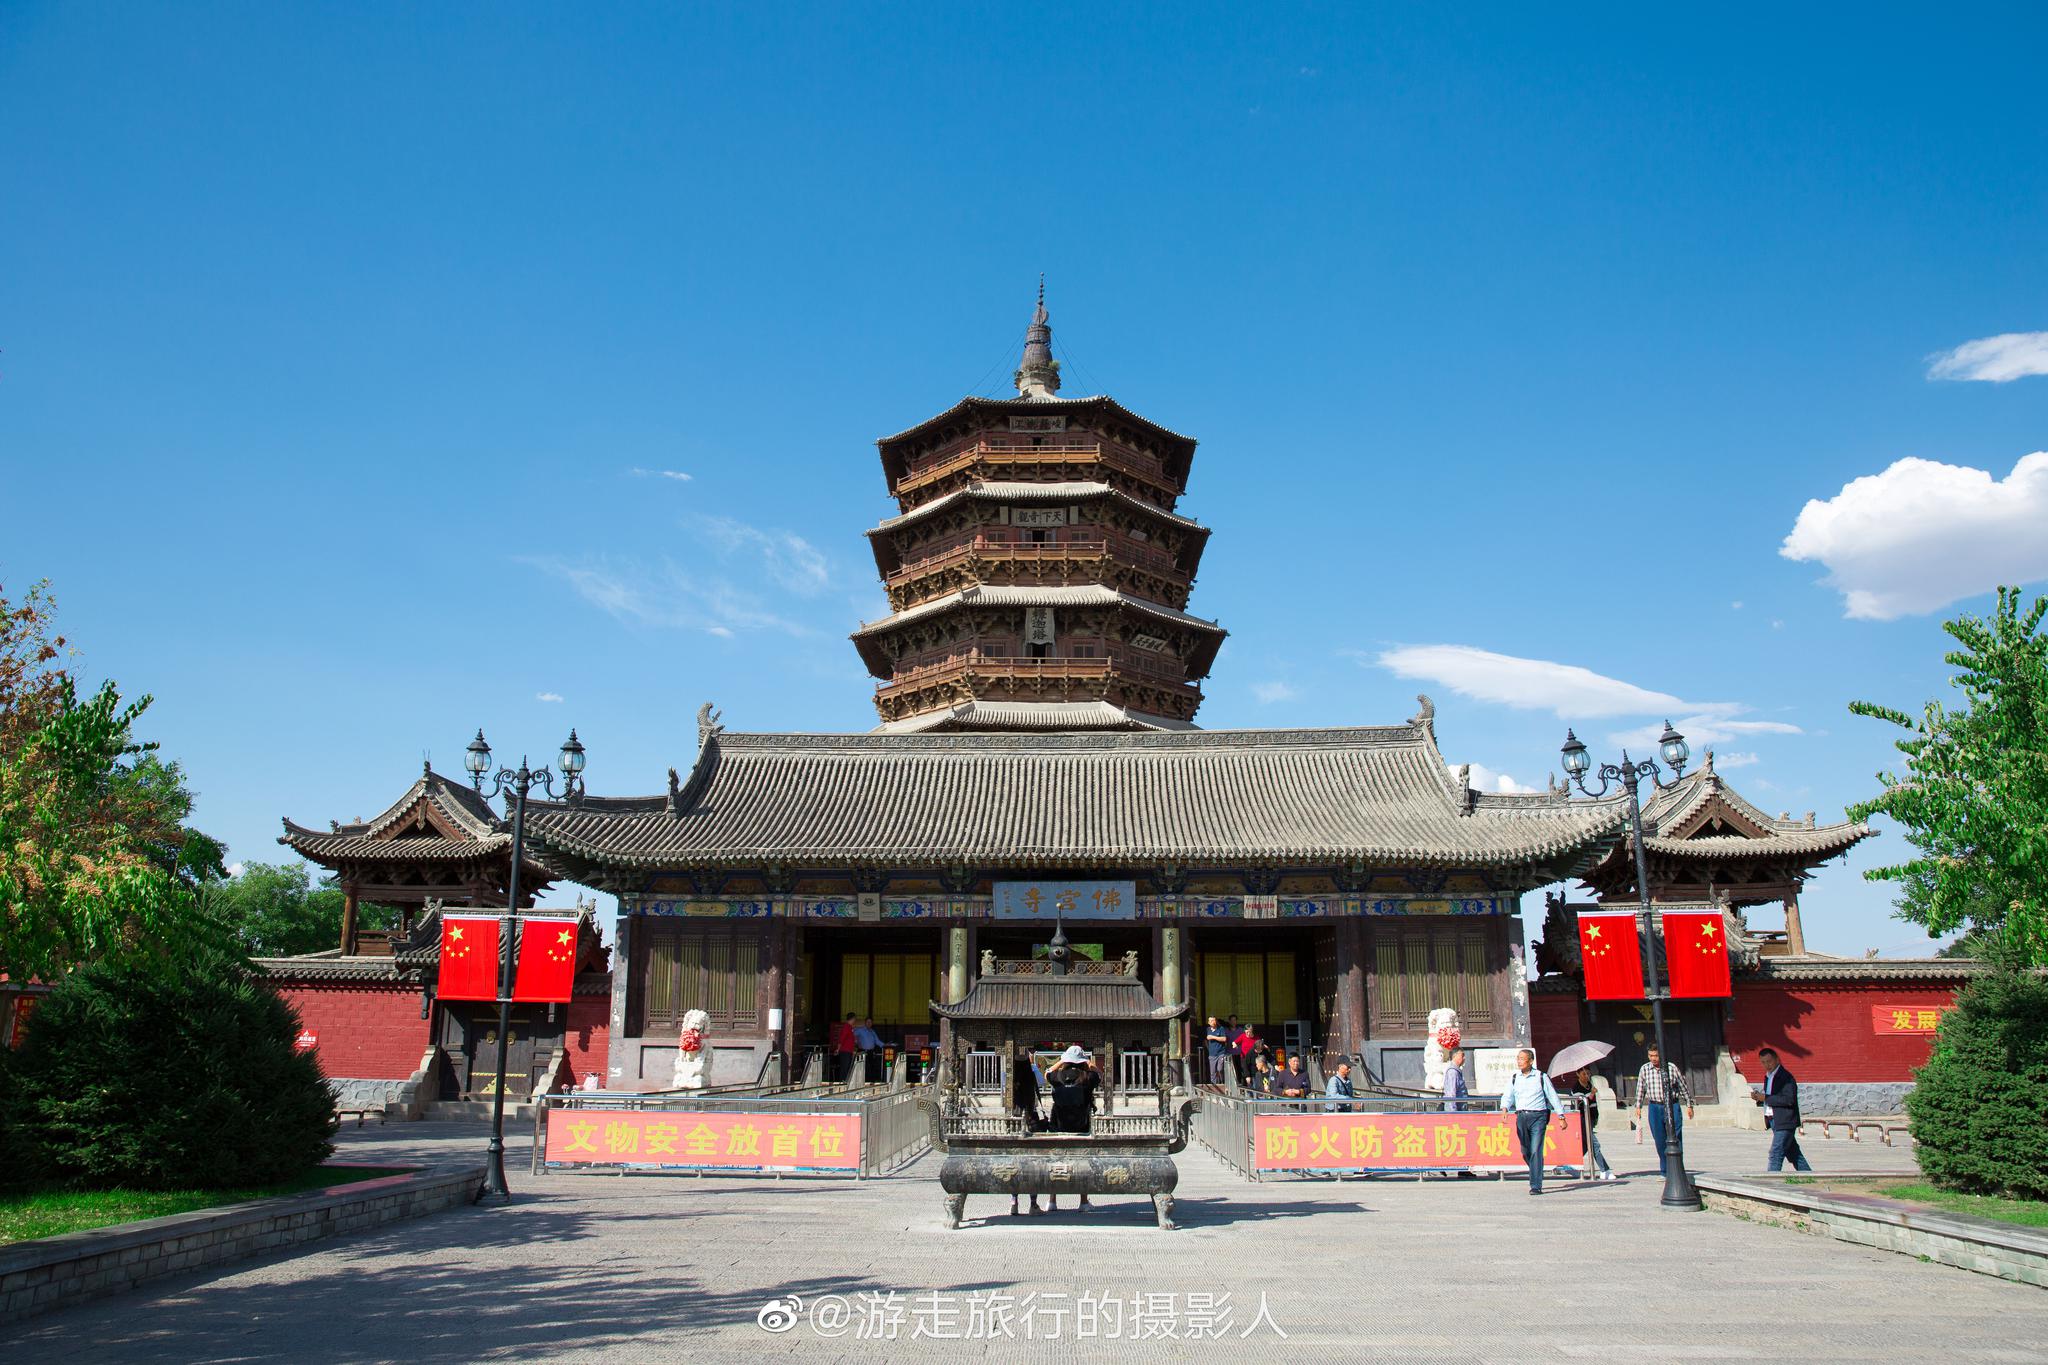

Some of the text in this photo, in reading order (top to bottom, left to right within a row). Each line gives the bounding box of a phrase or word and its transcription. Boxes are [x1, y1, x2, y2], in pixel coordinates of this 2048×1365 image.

[1892, 1009, 1937, 1030] 发展
[564, 1119, 844, 1158] 文物安全放首位
